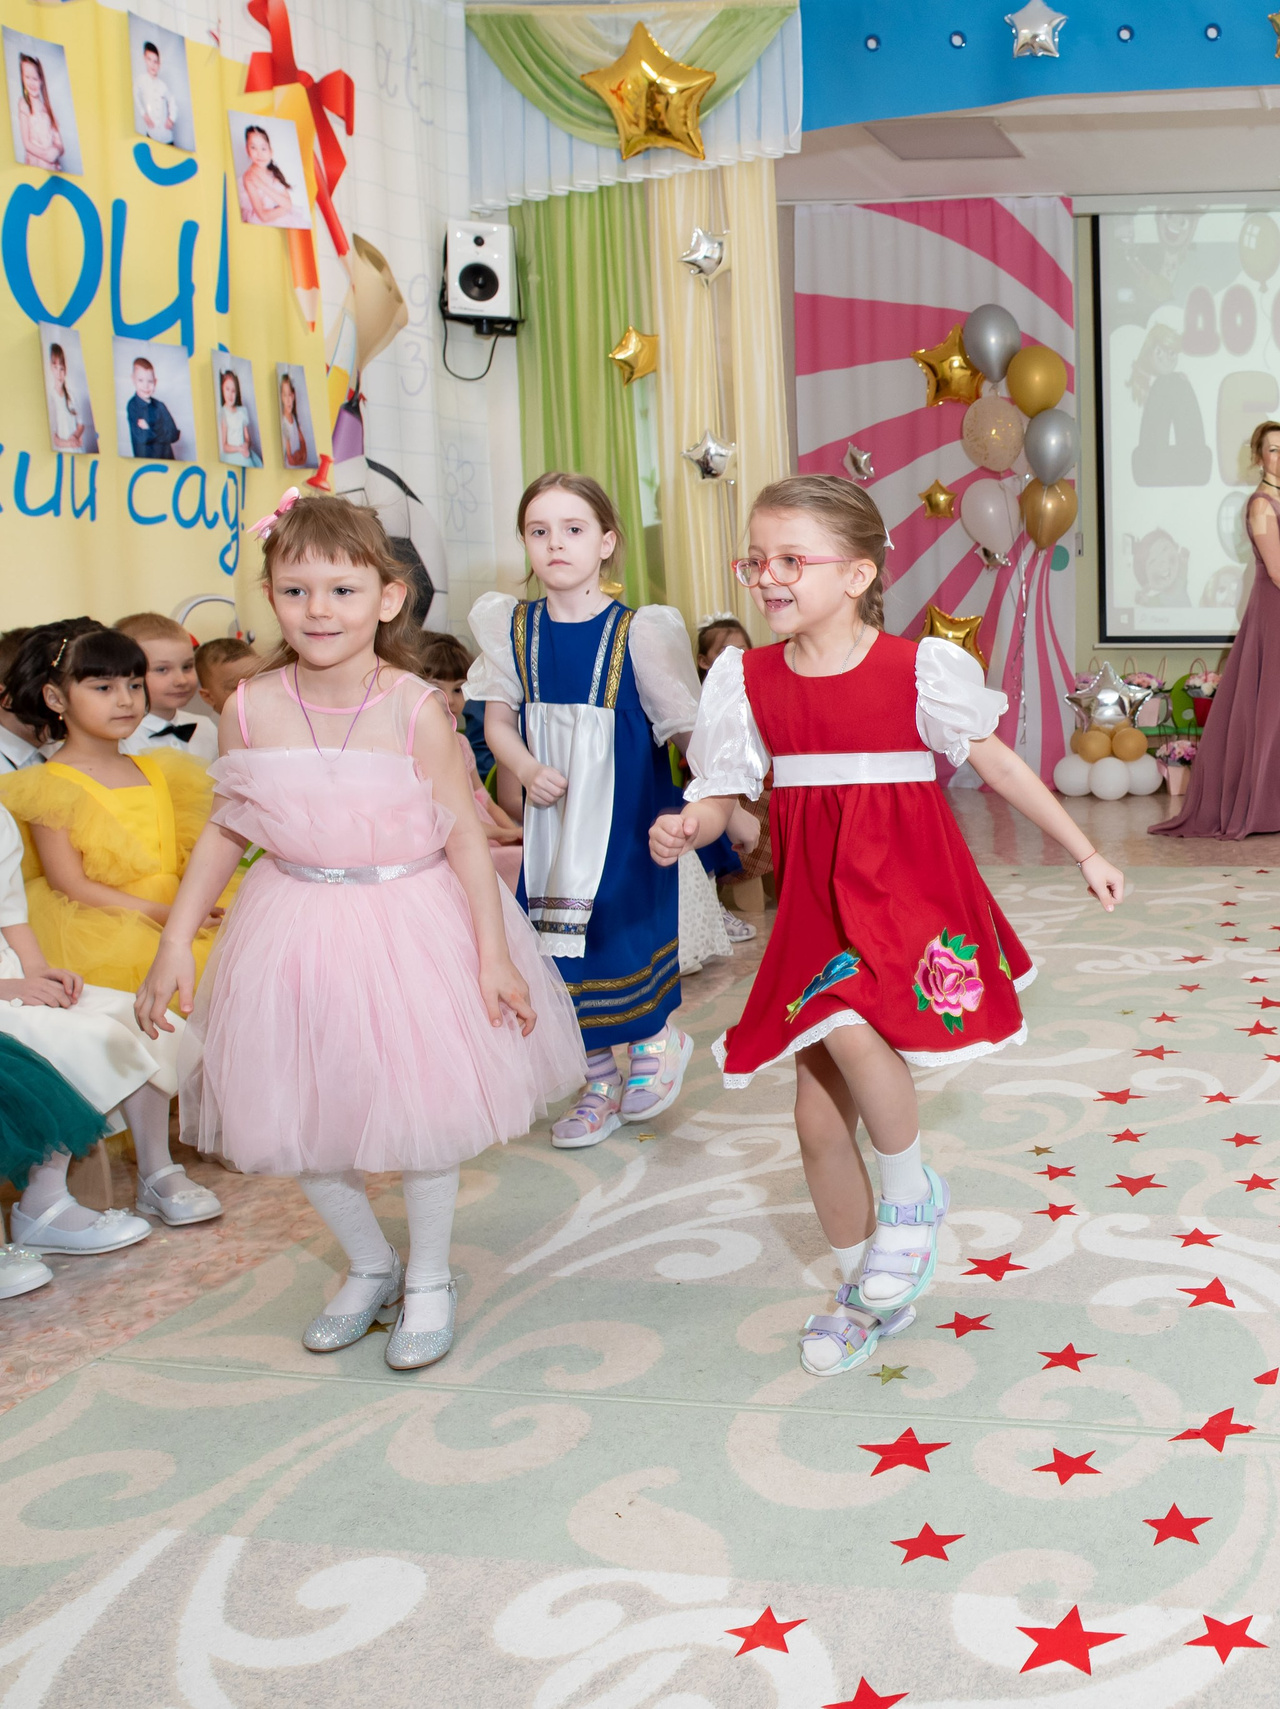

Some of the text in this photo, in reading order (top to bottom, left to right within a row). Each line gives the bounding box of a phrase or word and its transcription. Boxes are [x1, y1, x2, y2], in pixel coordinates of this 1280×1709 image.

[1181, 285, 1257, 357] ДО
[0, 432, 247, 577] ий сад!
